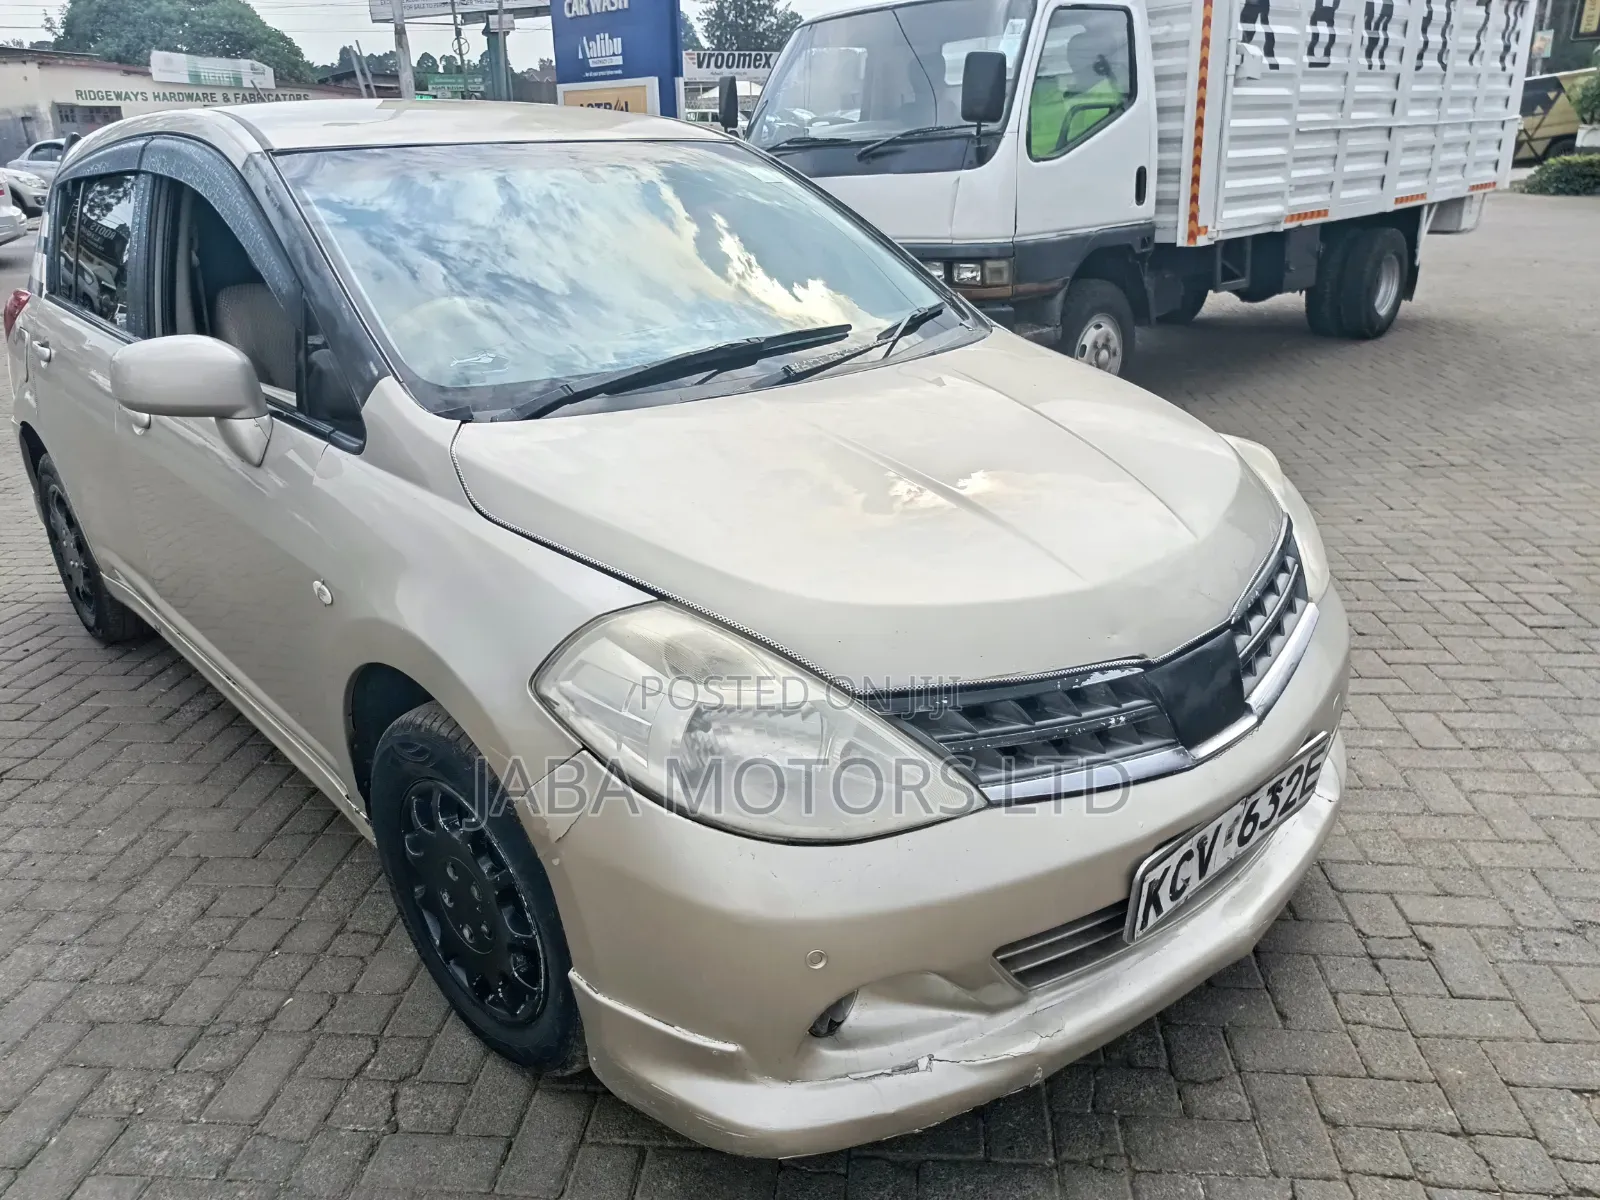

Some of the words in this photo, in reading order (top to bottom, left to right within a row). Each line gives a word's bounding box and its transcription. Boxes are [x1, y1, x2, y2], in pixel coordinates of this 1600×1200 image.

[564, 0, 590, 18] CAR
[590, 0, 629, 14] WASH
[578, 32, 622, 59] Malibu
[696, 52, 773, 69] vroomex
[75, 89, 148, 101] RIDGEWAYS
[152, 91, 218, 103] HARDWARE
[221, 92, 232, 103] &
[1139, 822, 1223, 931] KCV
[1236, 743, 1328, 849] 632E
